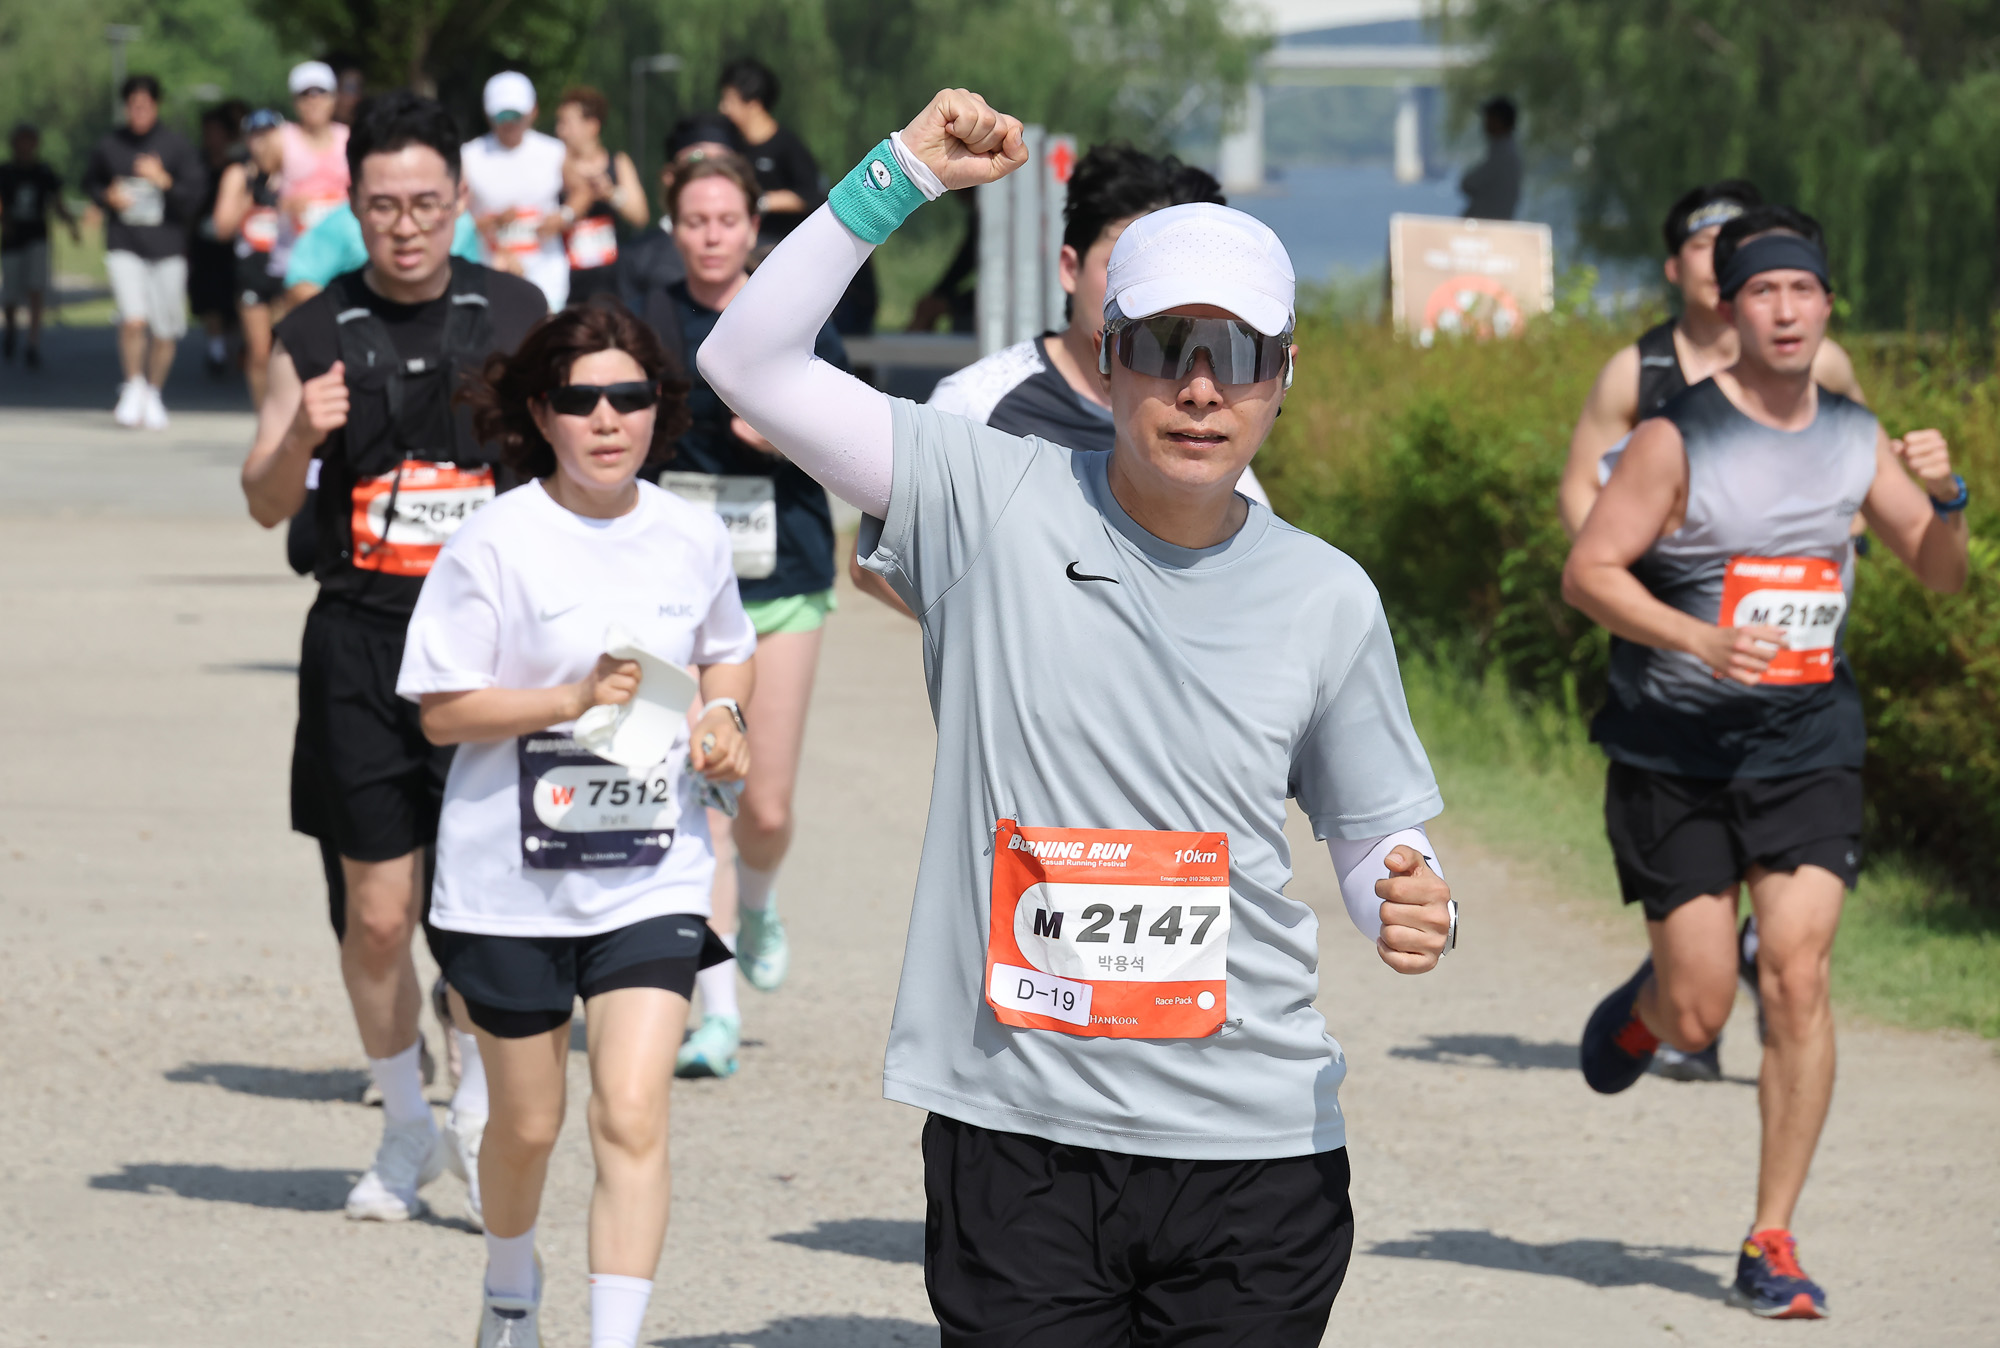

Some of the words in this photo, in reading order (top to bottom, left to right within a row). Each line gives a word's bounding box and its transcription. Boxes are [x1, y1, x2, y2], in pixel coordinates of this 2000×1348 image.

[552, 787, 576, 806] W
[587, 779, 668, 806] 7512
[1007, 834, 1085, 858] BURNING
[1087, 842, 1133, 860] RUN
[1040, 858, 1065, 866] Casual
[1066, 858, 1097, 868] Running
[1098, 860, 1127, 868] Festival
[1174, 849, 1217, 864] 10km
[1160, 875, 1188, 883] Emergency
[1033, 908, 1064, 939] M
[1075, 903, 1221, 945] 2147
[1098, 955, 1145, 973] 박용석
[1155, 996, 1174, 1006] Race
[1174, 995, 1193, 1006] Pack
